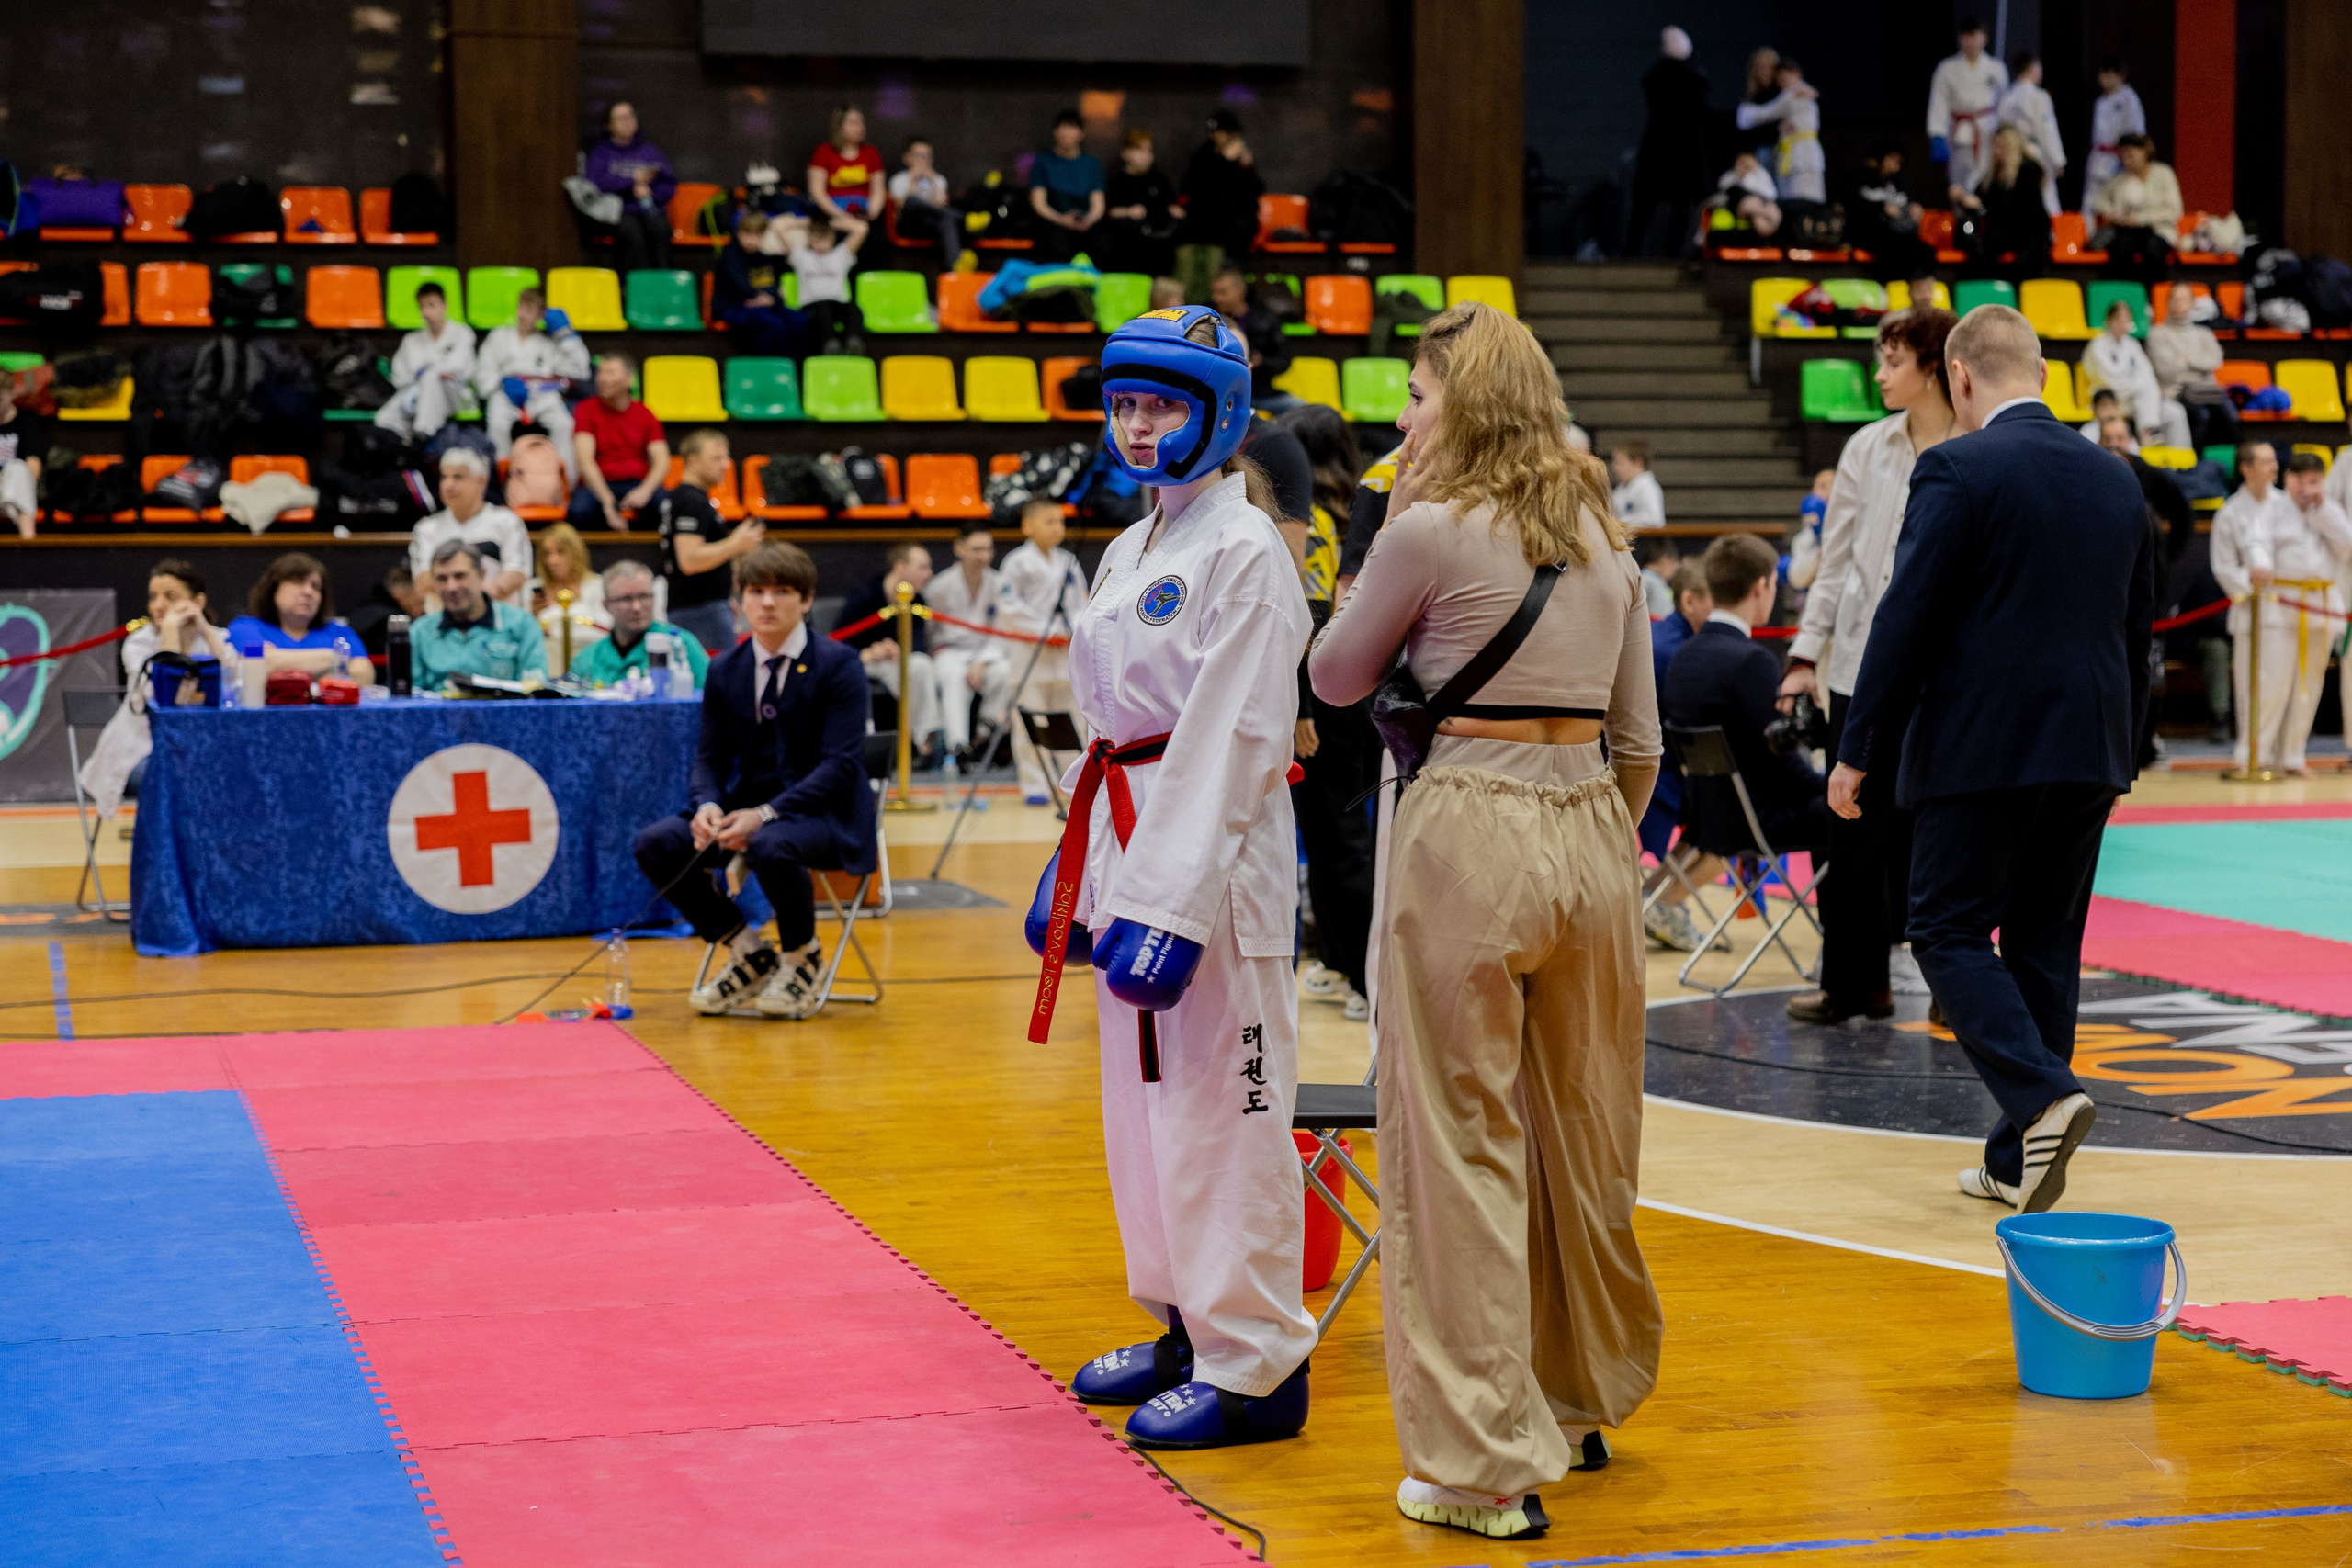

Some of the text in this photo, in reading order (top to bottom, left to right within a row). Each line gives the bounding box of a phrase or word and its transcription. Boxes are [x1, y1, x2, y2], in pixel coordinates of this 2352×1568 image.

[1149, 610, 1178, 623] FEDERATION
[1151, 954, 1166, 975] Point
[1240, 1023, 1269, 1115] 태권도
